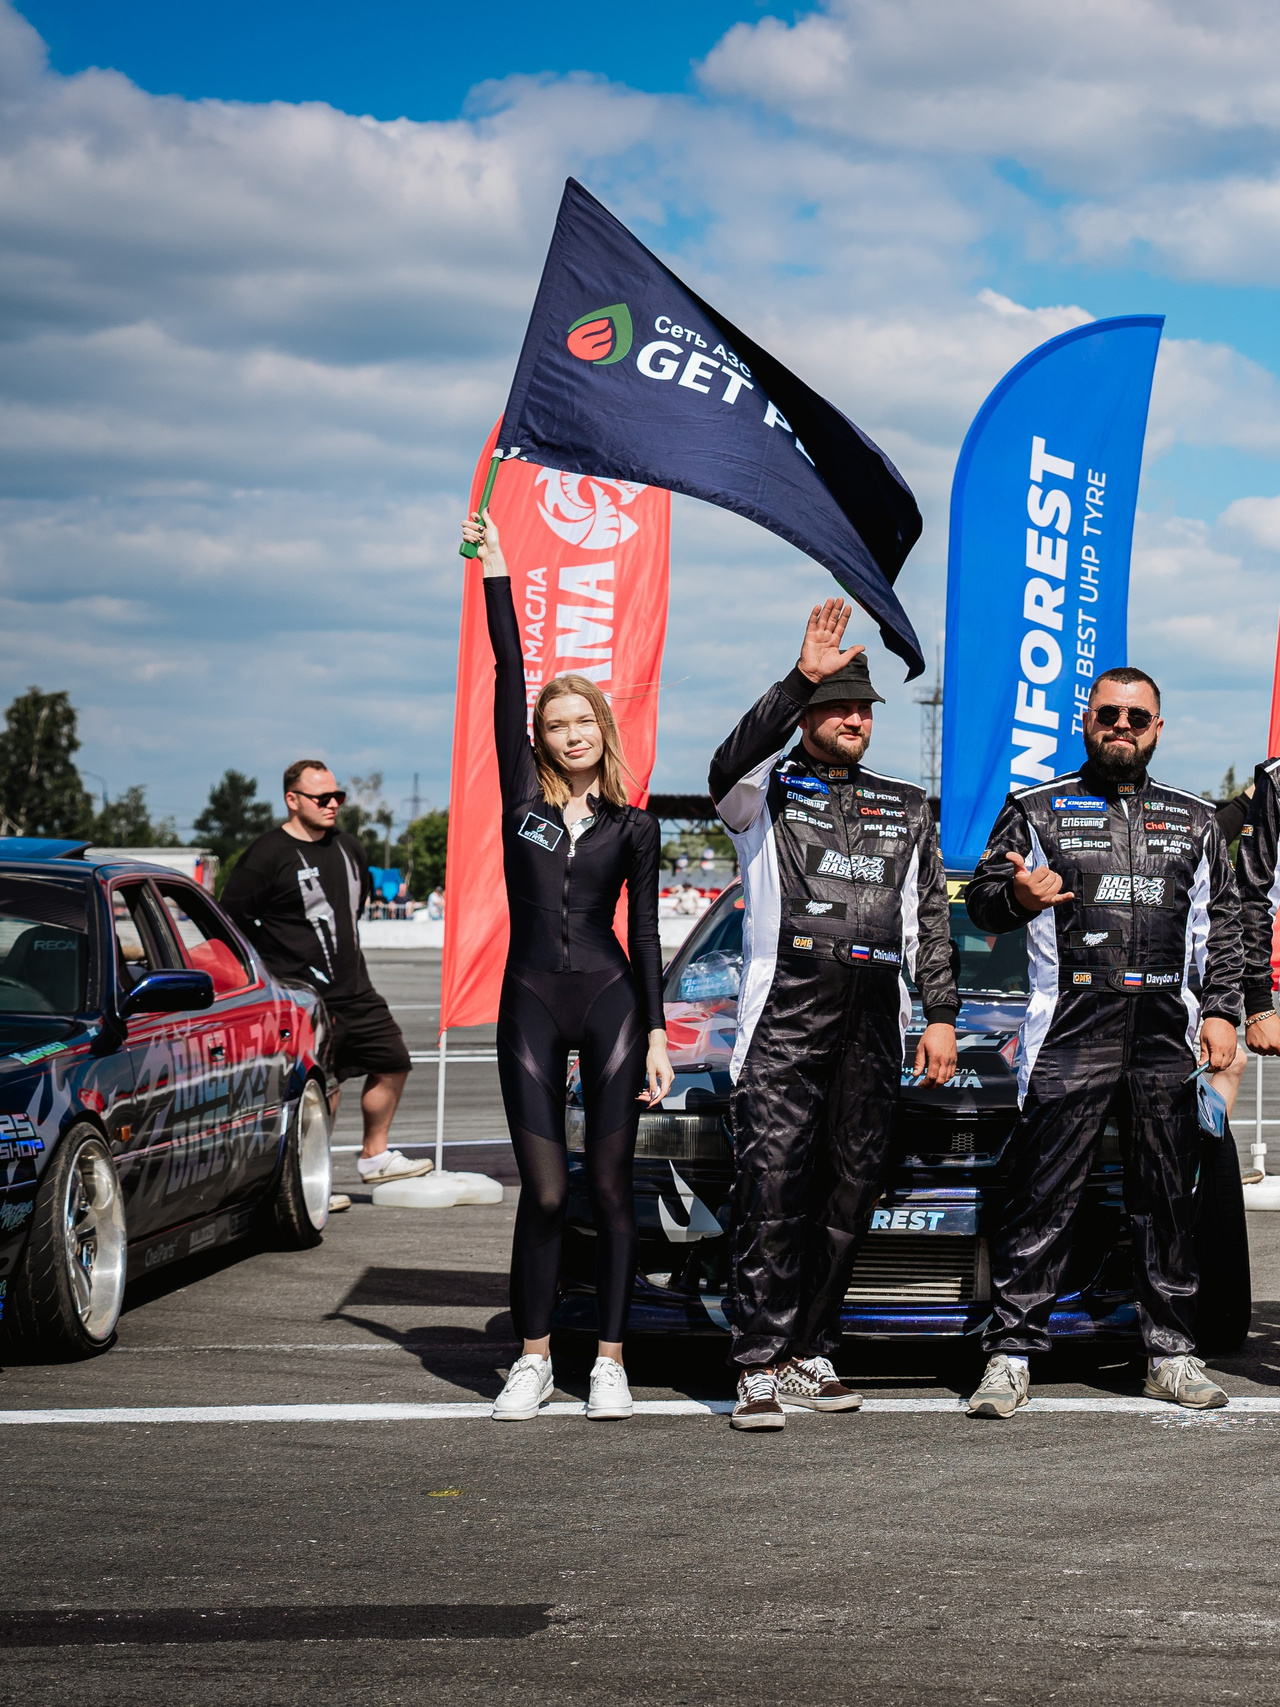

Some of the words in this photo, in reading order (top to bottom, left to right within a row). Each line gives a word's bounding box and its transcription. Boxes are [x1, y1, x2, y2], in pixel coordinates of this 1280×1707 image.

[654, 315, 708, 349] Сеть
[636, 340, 754, 405] GET
[1083, 468, 1106, 538] TYRE
[1079, 545, 1101, 603] UHP
[525, 566, 548, 662] МАСЛА
[1076, 608, 1097, 678] BEST
[860, 806, 903, 818] ChelParts
[1165, 806, 1190, 816] PETROL
[1145, 821, 1188, 833] ChelParts
[879, 830, 898, 838] PRO
[1060, 838, 1082, 850] 25
[1083, 840, 1111, 848] SHOP
[1163, 846, 1181, 854] PRO
[1095, 888, 1132, 901] BASE
[1146, 973, 1173, 985] Davydov
